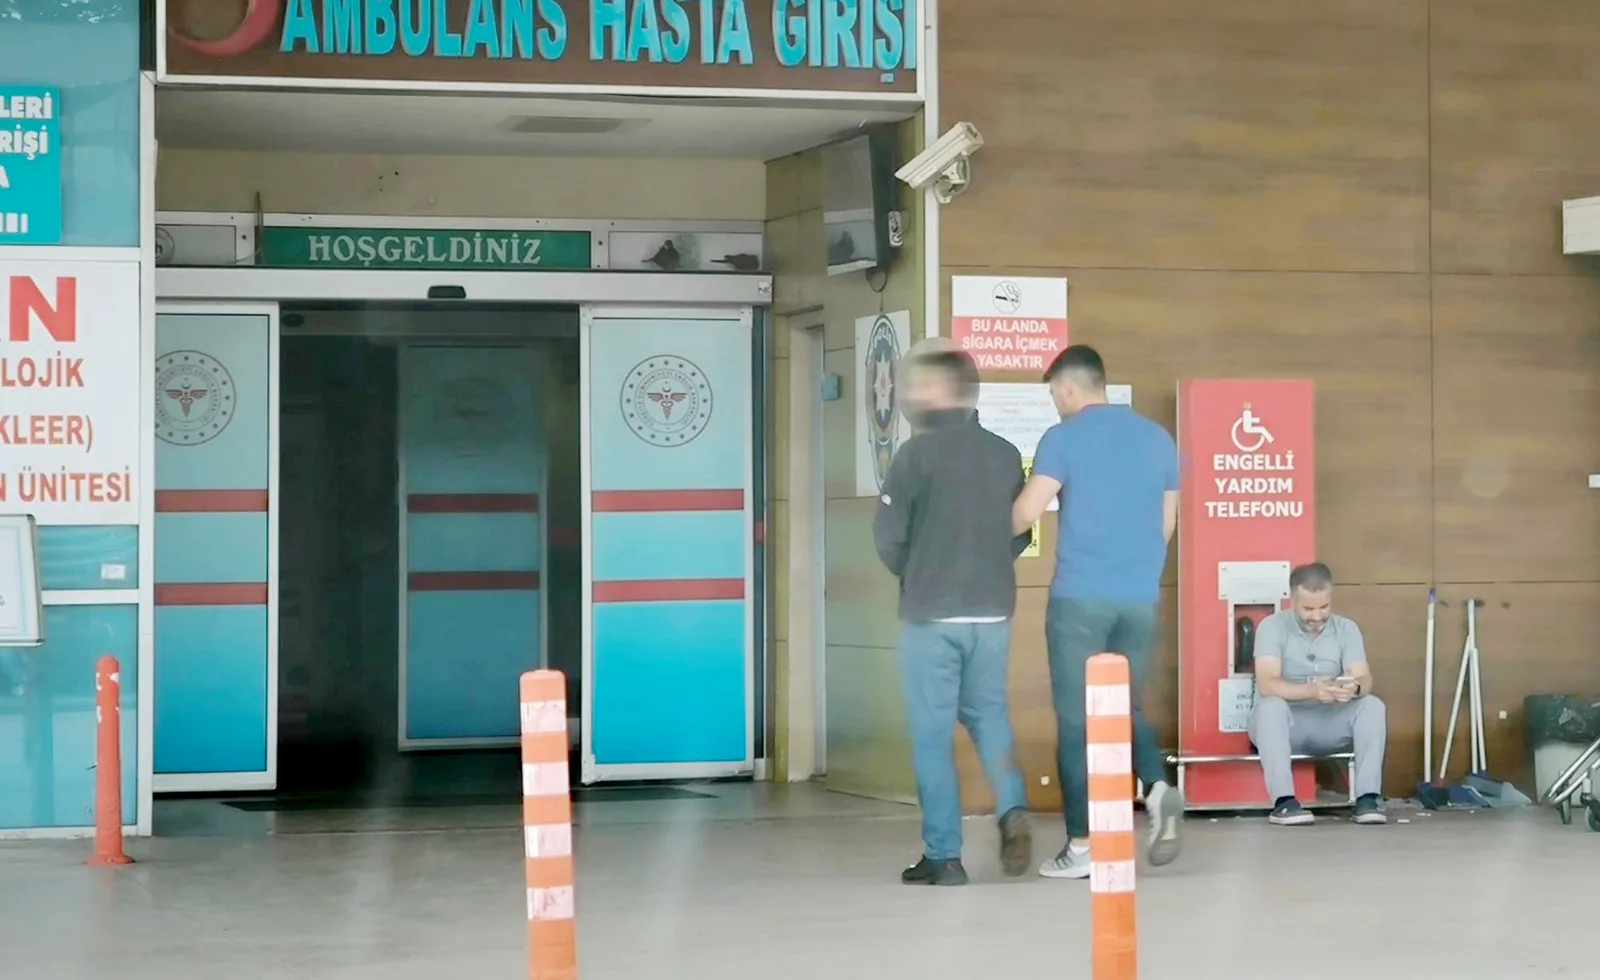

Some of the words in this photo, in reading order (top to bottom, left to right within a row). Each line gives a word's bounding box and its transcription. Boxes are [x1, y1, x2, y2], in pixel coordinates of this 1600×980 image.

[279, 0, 567, 60] AMBULANS
[589, 0, 754, 65] HASTA
[307, 231, 542, 267] HOŞGELDİNİZ
[971, 318, 990, 332] BU
[994, 320, 1049, 334] ALANDA
[962, 334, 1013, 350] SİGARA
[1016, 335, 1058, 354] İÇMEK
[1, 350, 84, 387] LOJİK
[977, 355, 1043, 368] YASAKTIR
[1213, 450, 1295, 471] ENGELLİ
[18, 465, 131, 503] ÜNİTESİ
[1215, 478, 1293, 494] YARDIM
[1204, 501, 1304, 518] TELEFONU
